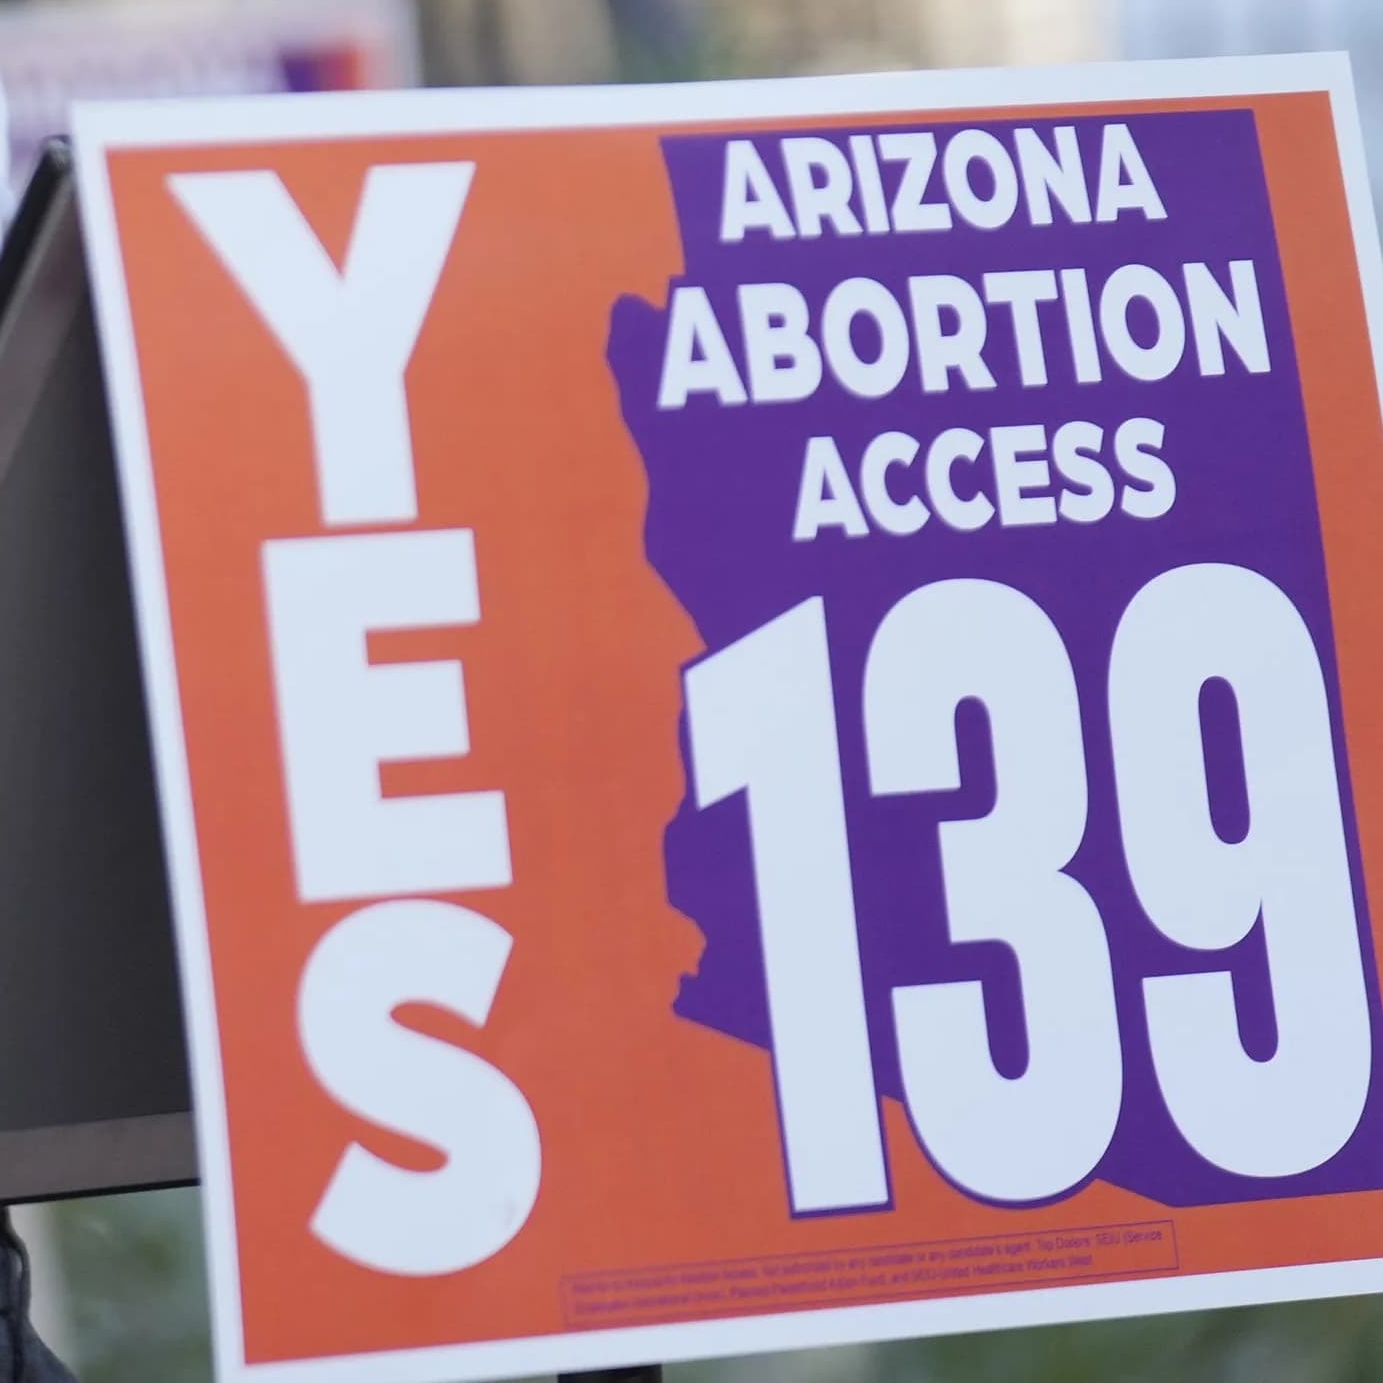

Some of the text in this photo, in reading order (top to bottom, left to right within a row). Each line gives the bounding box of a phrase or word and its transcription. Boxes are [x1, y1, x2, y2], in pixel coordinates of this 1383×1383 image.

[720, 123, 1167, 241] ARIZONA
[657, 259, 1271, 408] ABORTION
[793, 417, 1176, 541] ACCESS
[165, 161, 542, 1277] YES
[683, 562, 1372, 1213] 139
